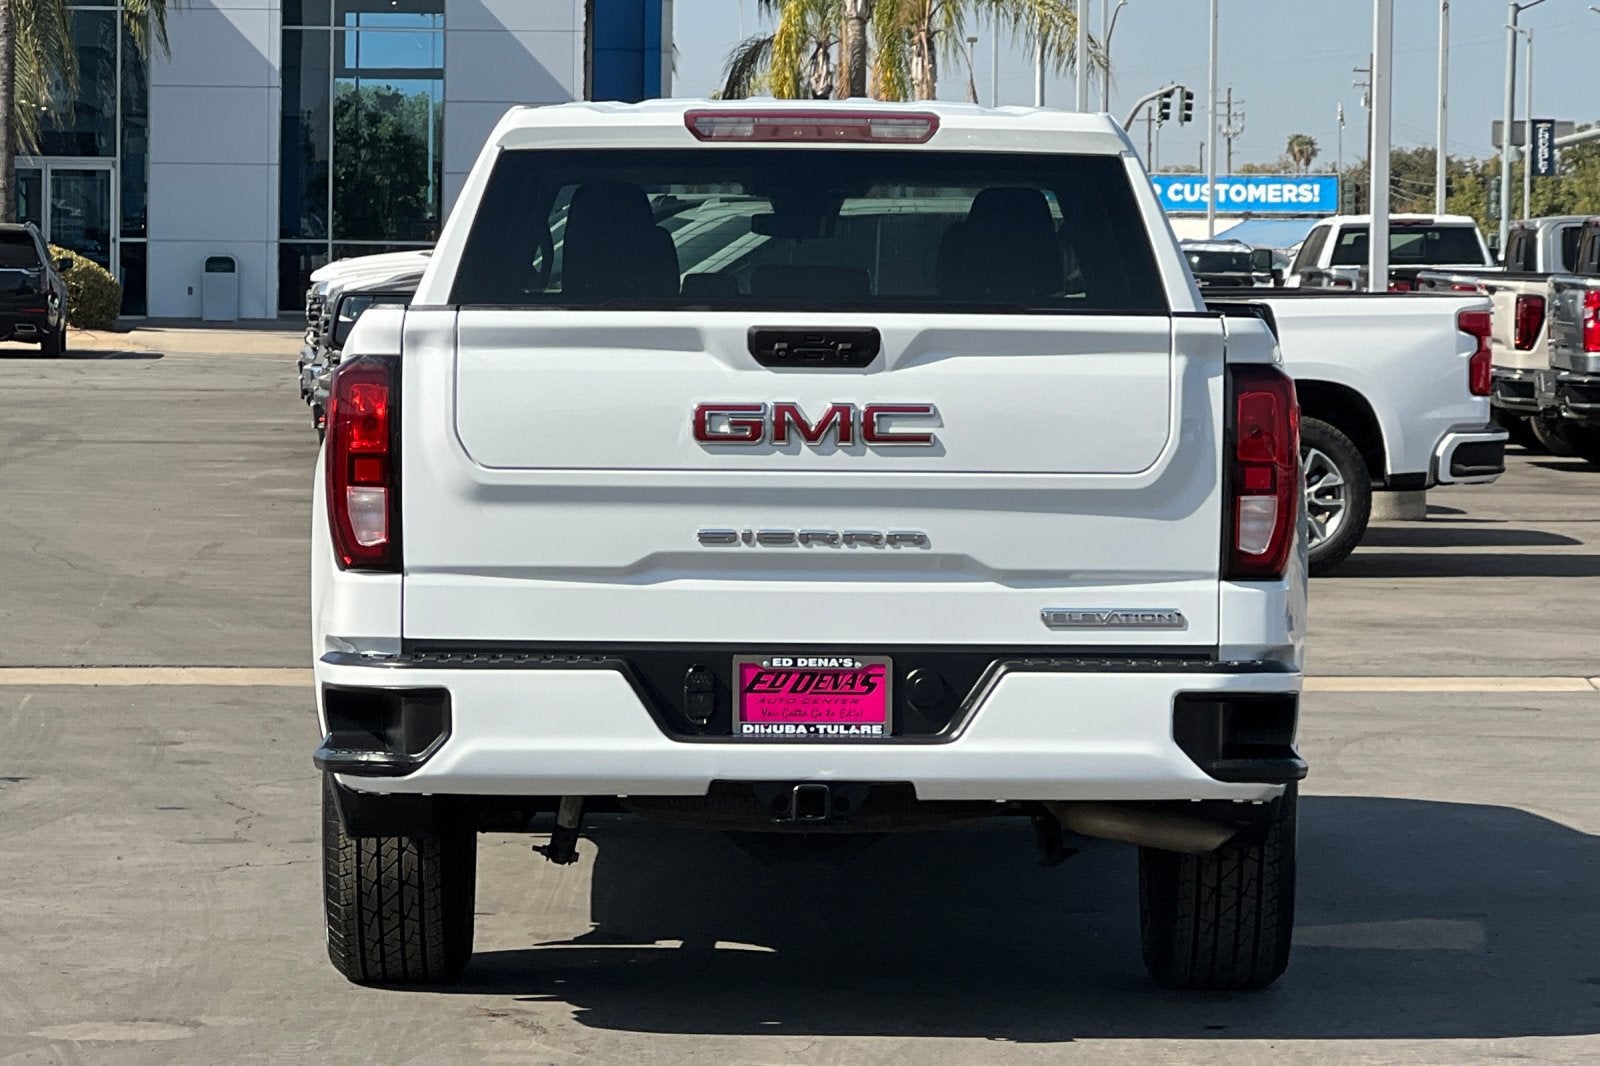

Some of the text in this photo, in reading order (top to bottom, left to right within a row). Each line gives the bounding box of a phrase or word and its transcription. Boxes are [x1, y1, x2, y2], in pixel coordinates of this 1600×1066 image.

[1167, 182, 1321, 203] CUSTOMERS!
[693, 402, 935, 446] GMC
[697, 528, 928, 546] SIERRA
[1048, 611, 1181, 625] ELEVATION
[772, 657, 853, 668] ED DENA'S
[743, 671, 885, 695] ED DENA'S
[756, 697, 860, 705] AUTO CENTER
[816, 724, 883, 734] TULARE
